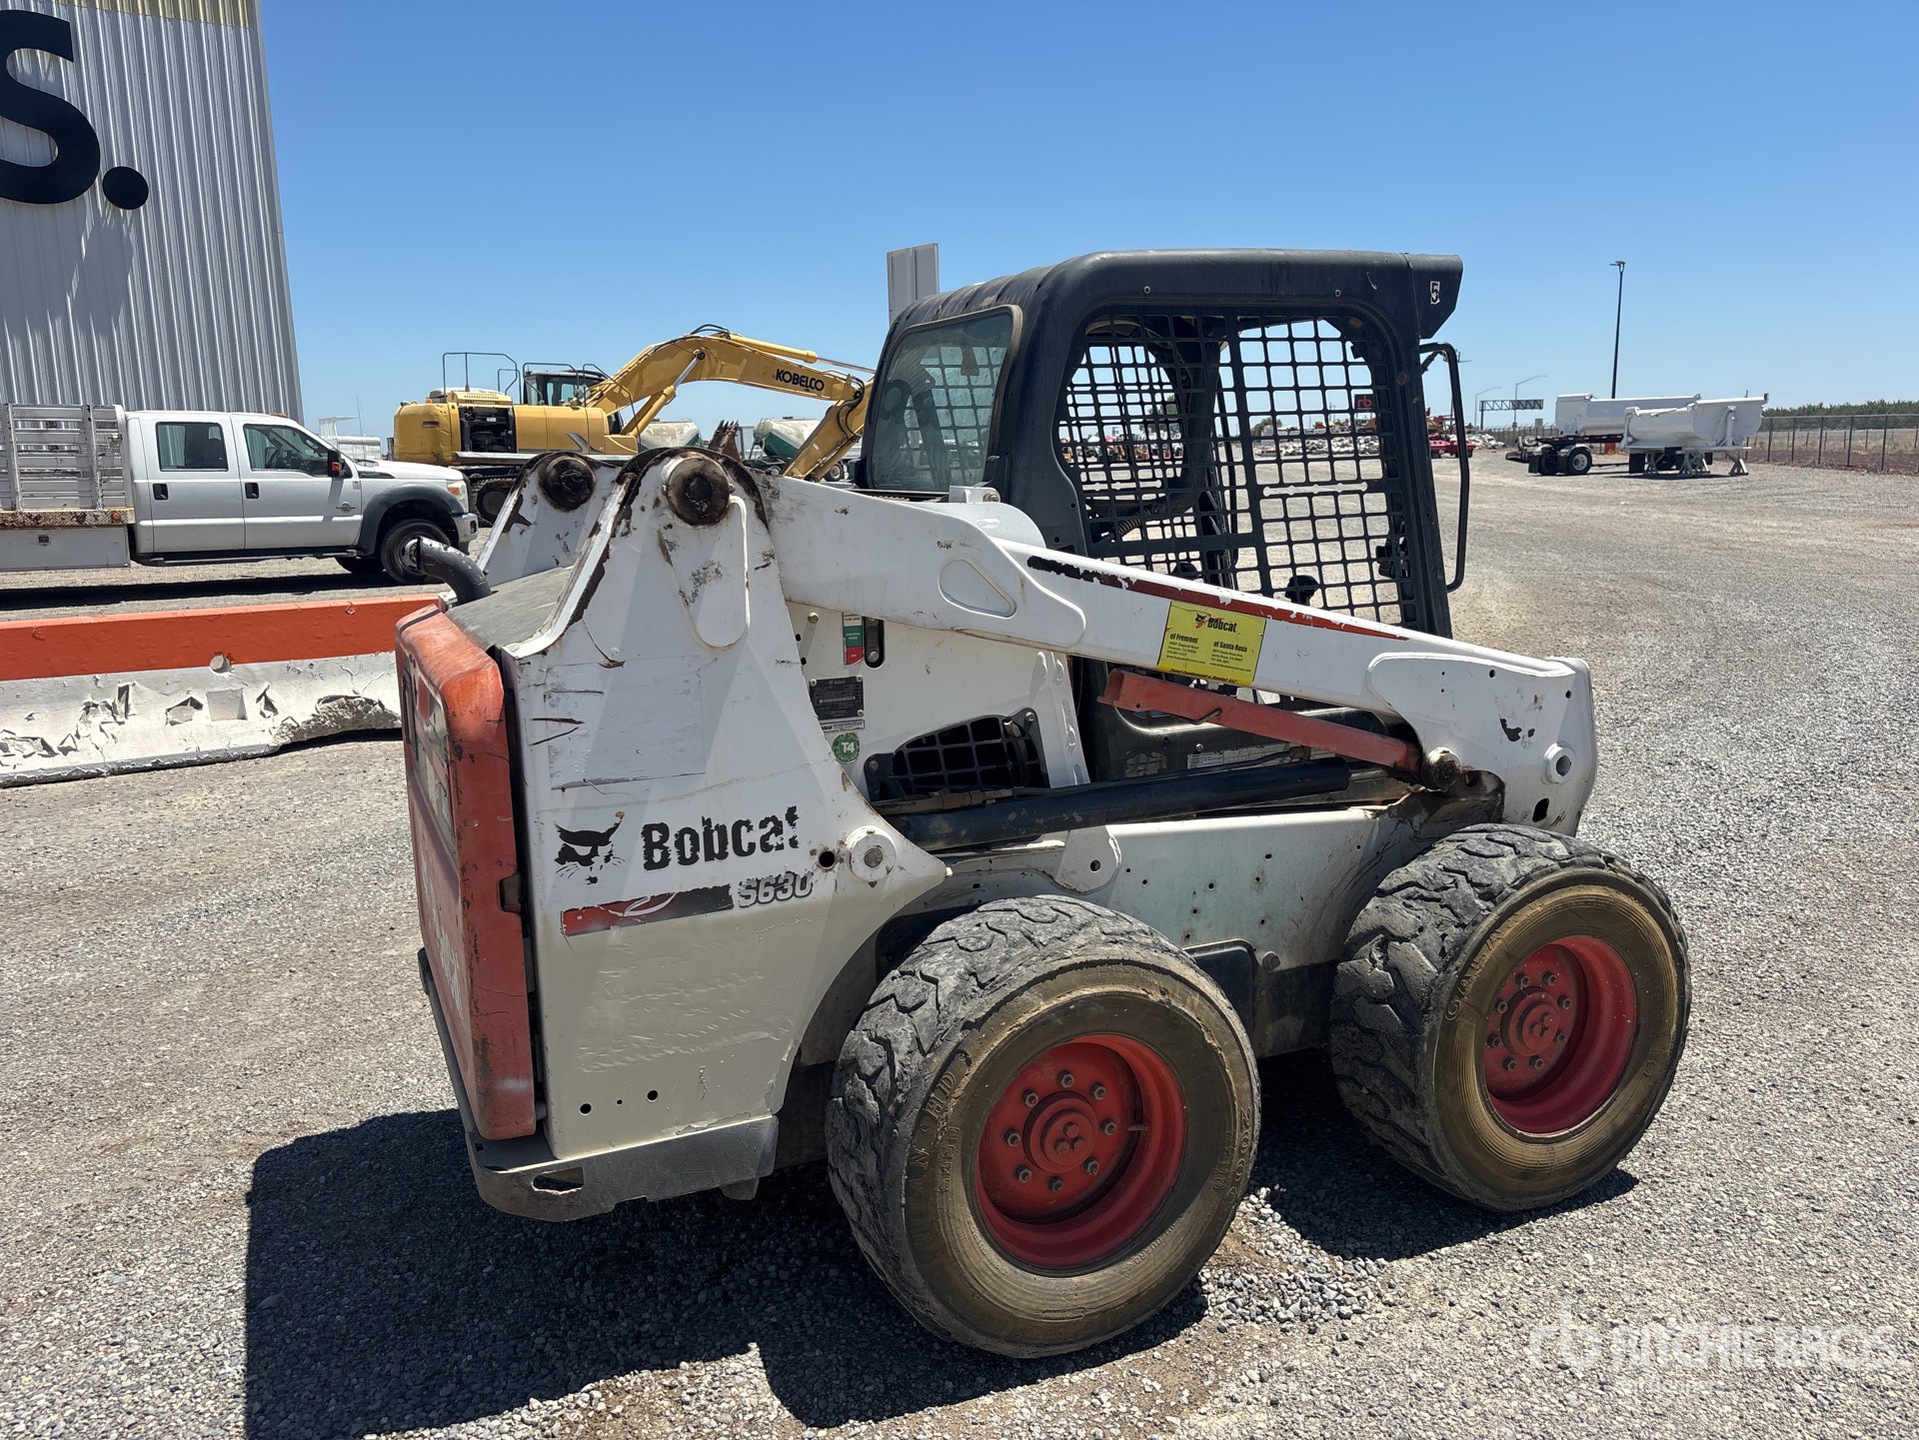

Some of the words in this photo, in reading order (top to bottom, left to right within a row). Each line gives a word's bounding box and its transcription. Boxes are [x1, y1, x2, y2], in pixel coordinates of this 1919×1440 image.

[775, 368, 825, 391] KOBELCO
[1357, 395, 1372, 408] rb
[1207, 617, 1238, 633] Bobcat
[1177, 634, 1199, 644] Fremont
[1219, 641, 1235, 650] Santa
[1234, 644, 1248, 653] Rosa
[841, 742, 855, 753] T4
[641, 805, 799, 871] Bobcat
[738, 870, 814, 908] S630
[925, 1070, 957, 1121] HD
